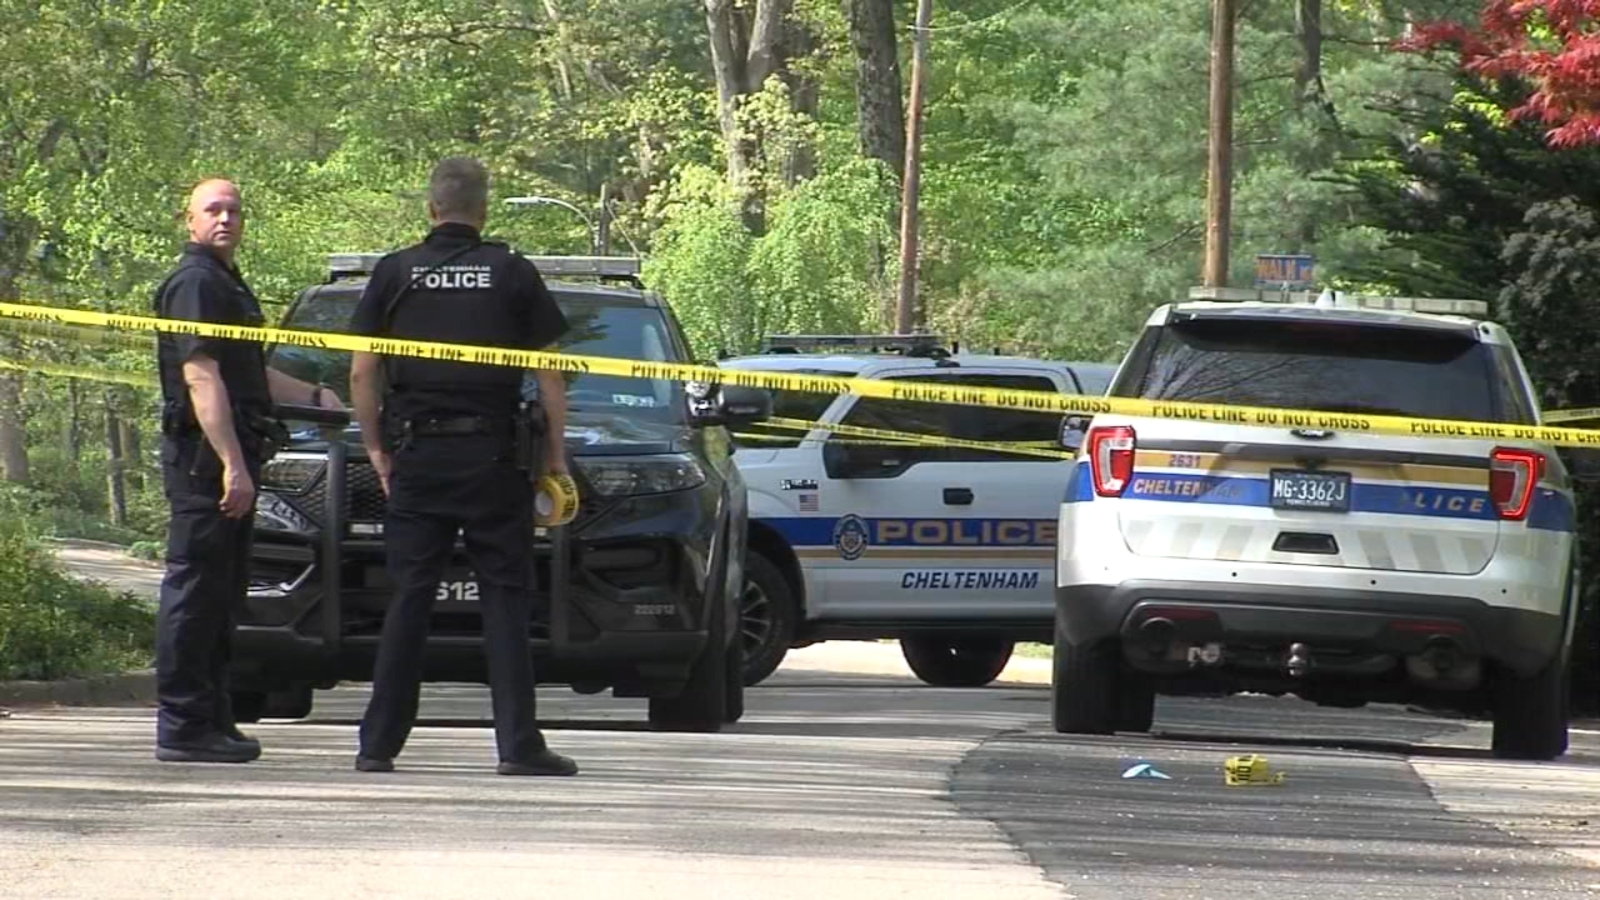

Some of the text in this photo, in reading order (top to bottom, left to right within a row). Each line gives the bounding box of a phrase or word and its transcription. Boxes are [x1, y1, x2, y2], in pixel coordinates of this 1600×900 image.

[411, 272, 492, 289] POLICE
[370, 341, 424, 356] POLICE
[431, 347, 466, 361] LINE
[538, 355, 590, 373] CROSS
[631, 363, 687, 380] POLICE
[692, 368, 727, 383] LINE
[799, 377, 852, 394] CROSS
[892, 386, 1112, 413] POLICE LINE DO NOT CROSS
[1152, 405, 1371, 431] POLICE LINE DO NOT CROSS
[1411, 421, 1467, 436] POLICE
[1470, 425, 1506, 438] LINE
[1514, 428, 1535, 440] DO
[1133, 477, 1238, 498] CHELTEN
[876, 520, 1057, 545] POLICE
[901, 571, 1039, 589] CHELTENHAM
